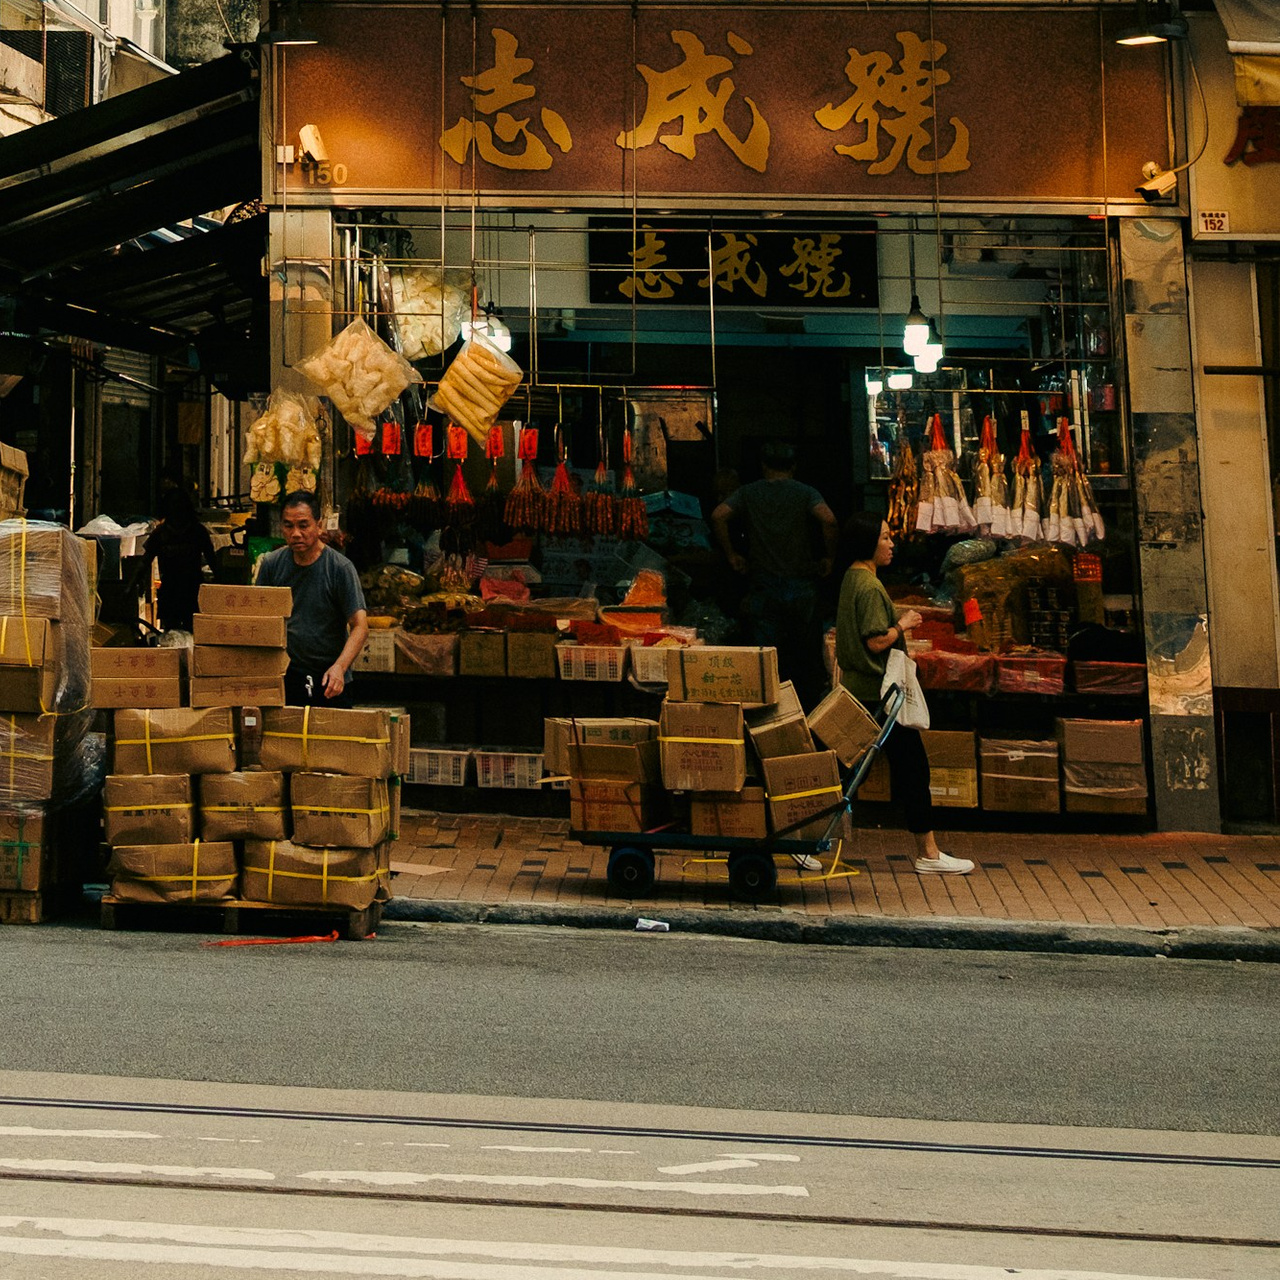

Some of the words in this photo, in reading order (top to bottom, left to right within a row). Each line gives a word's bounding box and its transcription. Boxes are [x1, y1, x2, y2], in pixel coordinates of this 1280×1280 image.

[439, 27, 972, 176] 志成號
[308, 162, 348, 185] 150
[1204, 218, 1225, 231] 152
[618, 223, 852, 299] 志成號
